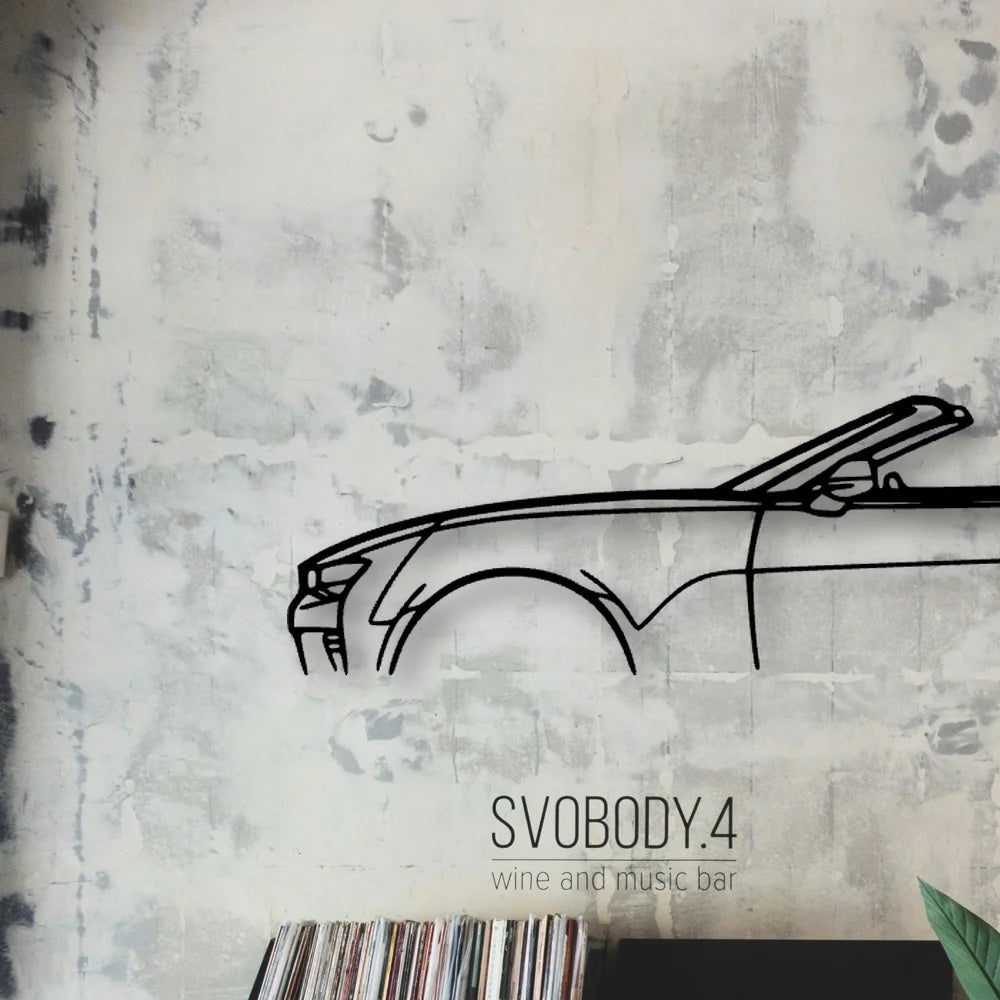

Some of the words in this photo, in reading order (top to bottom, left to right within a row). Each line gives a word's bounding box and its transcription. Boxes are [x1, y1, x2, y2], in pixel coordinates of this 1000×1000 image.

[492, 795, 737, 849] SVOBODY.4
[491, 867, 550, 891] wine
[560, 866, 606, 891] and
[616, 867, 688, 891] music
[698, 866, 737, 891] bar
